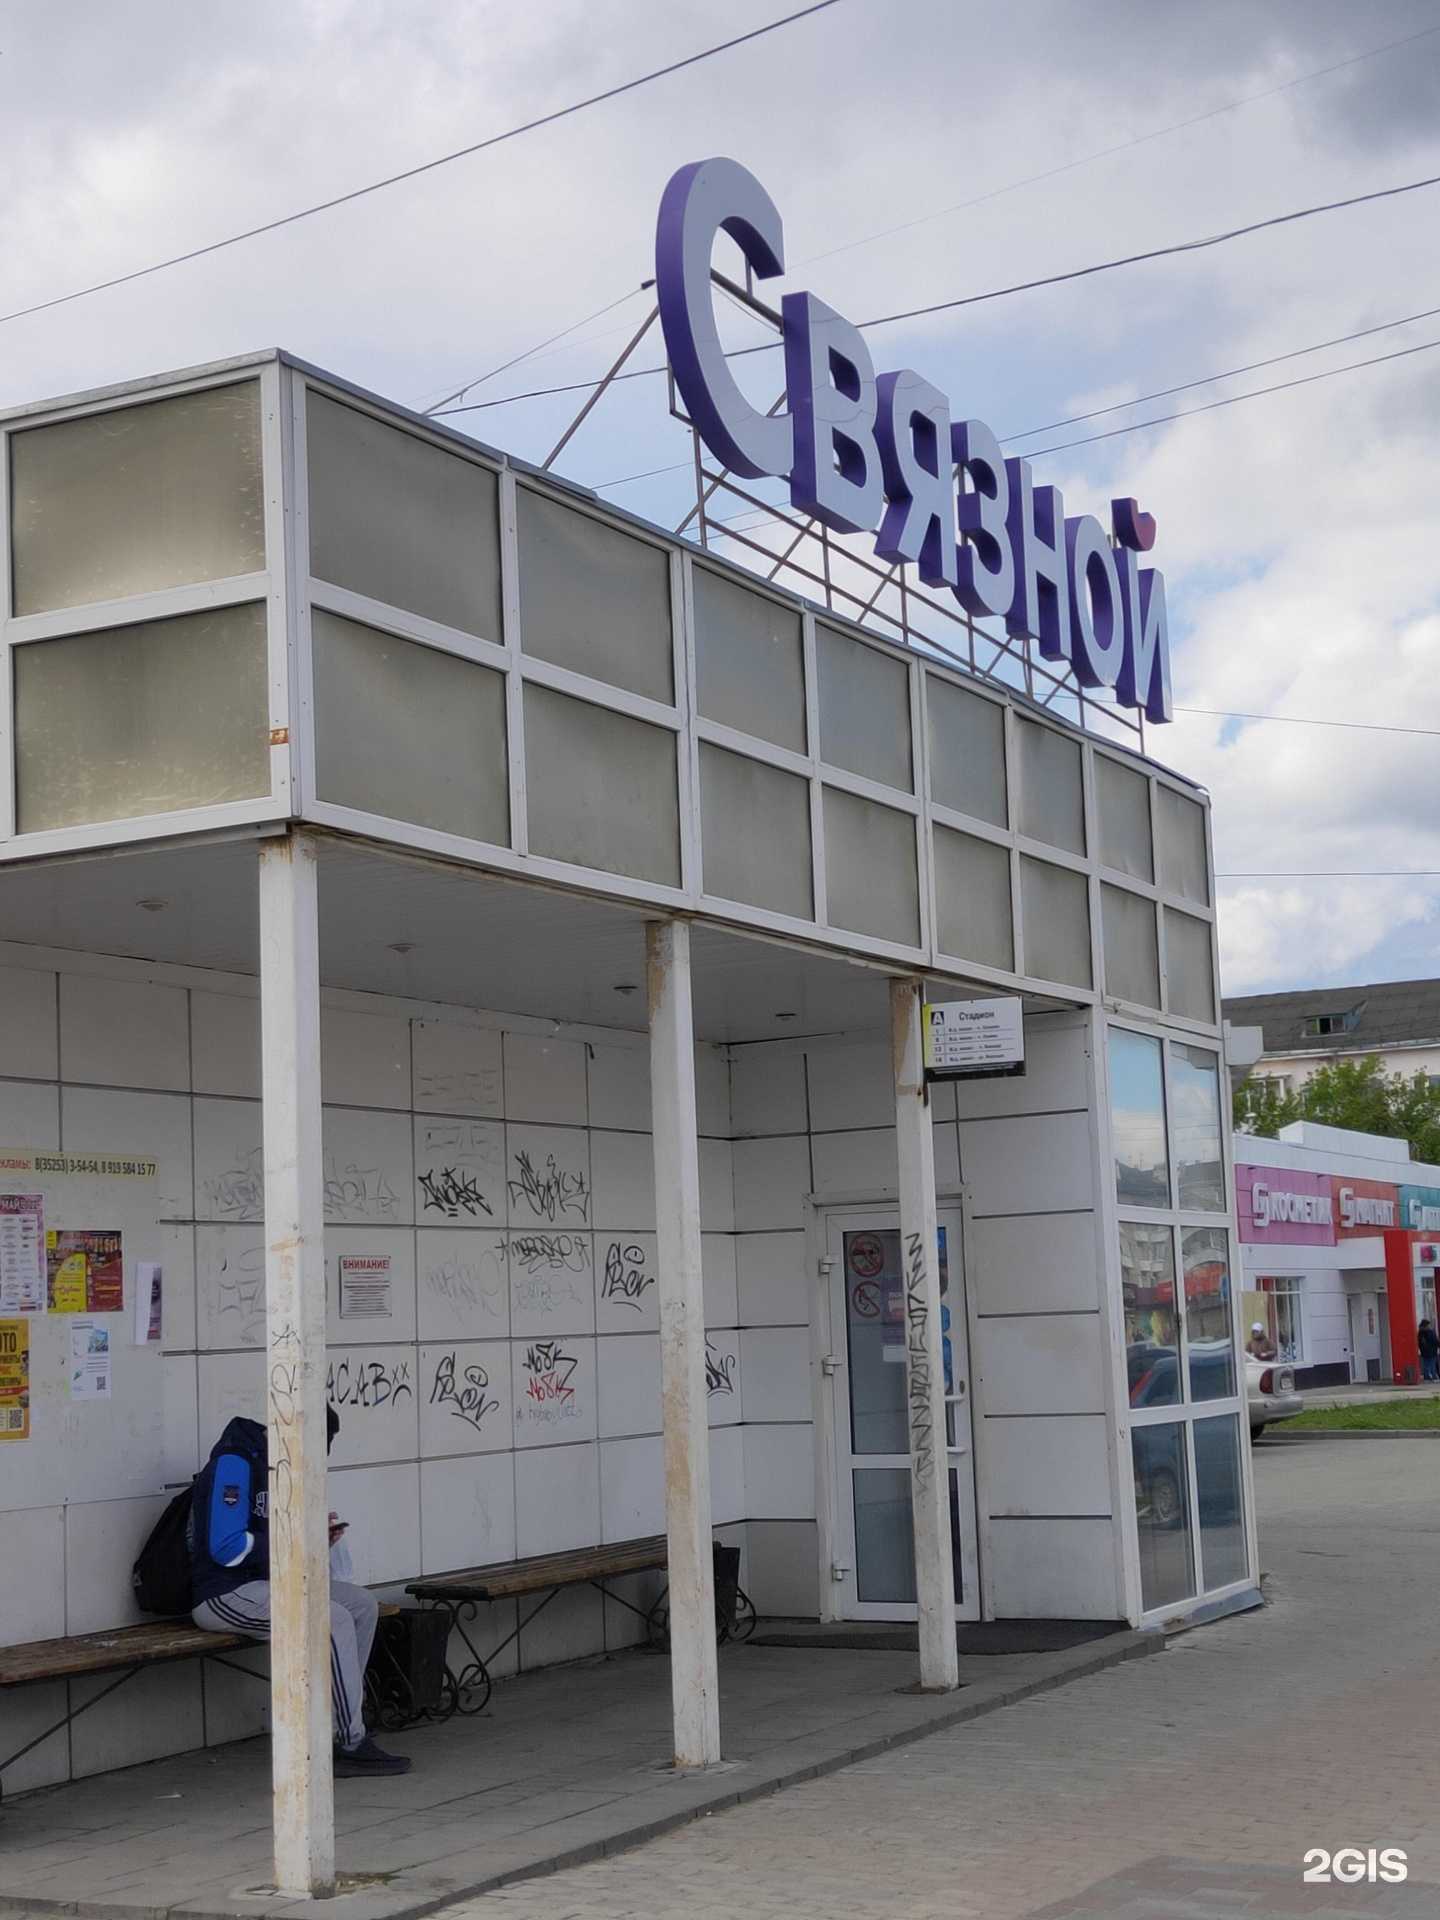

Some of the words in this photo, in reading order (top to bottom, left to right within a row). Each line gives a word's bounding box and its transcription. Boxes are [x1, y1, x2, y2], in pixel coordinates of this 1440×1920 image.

[959, 1011, 995, 1021] Стадион
[35, 1156, 68, 1174] 8(35253)
[102, 1160, 106, 1174] 8
[122, 1161, 136, 1175] 584
[137, 1162, 146, 1176] 15
[146, 1163, 156, 1177] 77
[343, 1259, 389, 1269] ВНИМАНИЕ!
[0, 1332, 17, 1353] ТО
